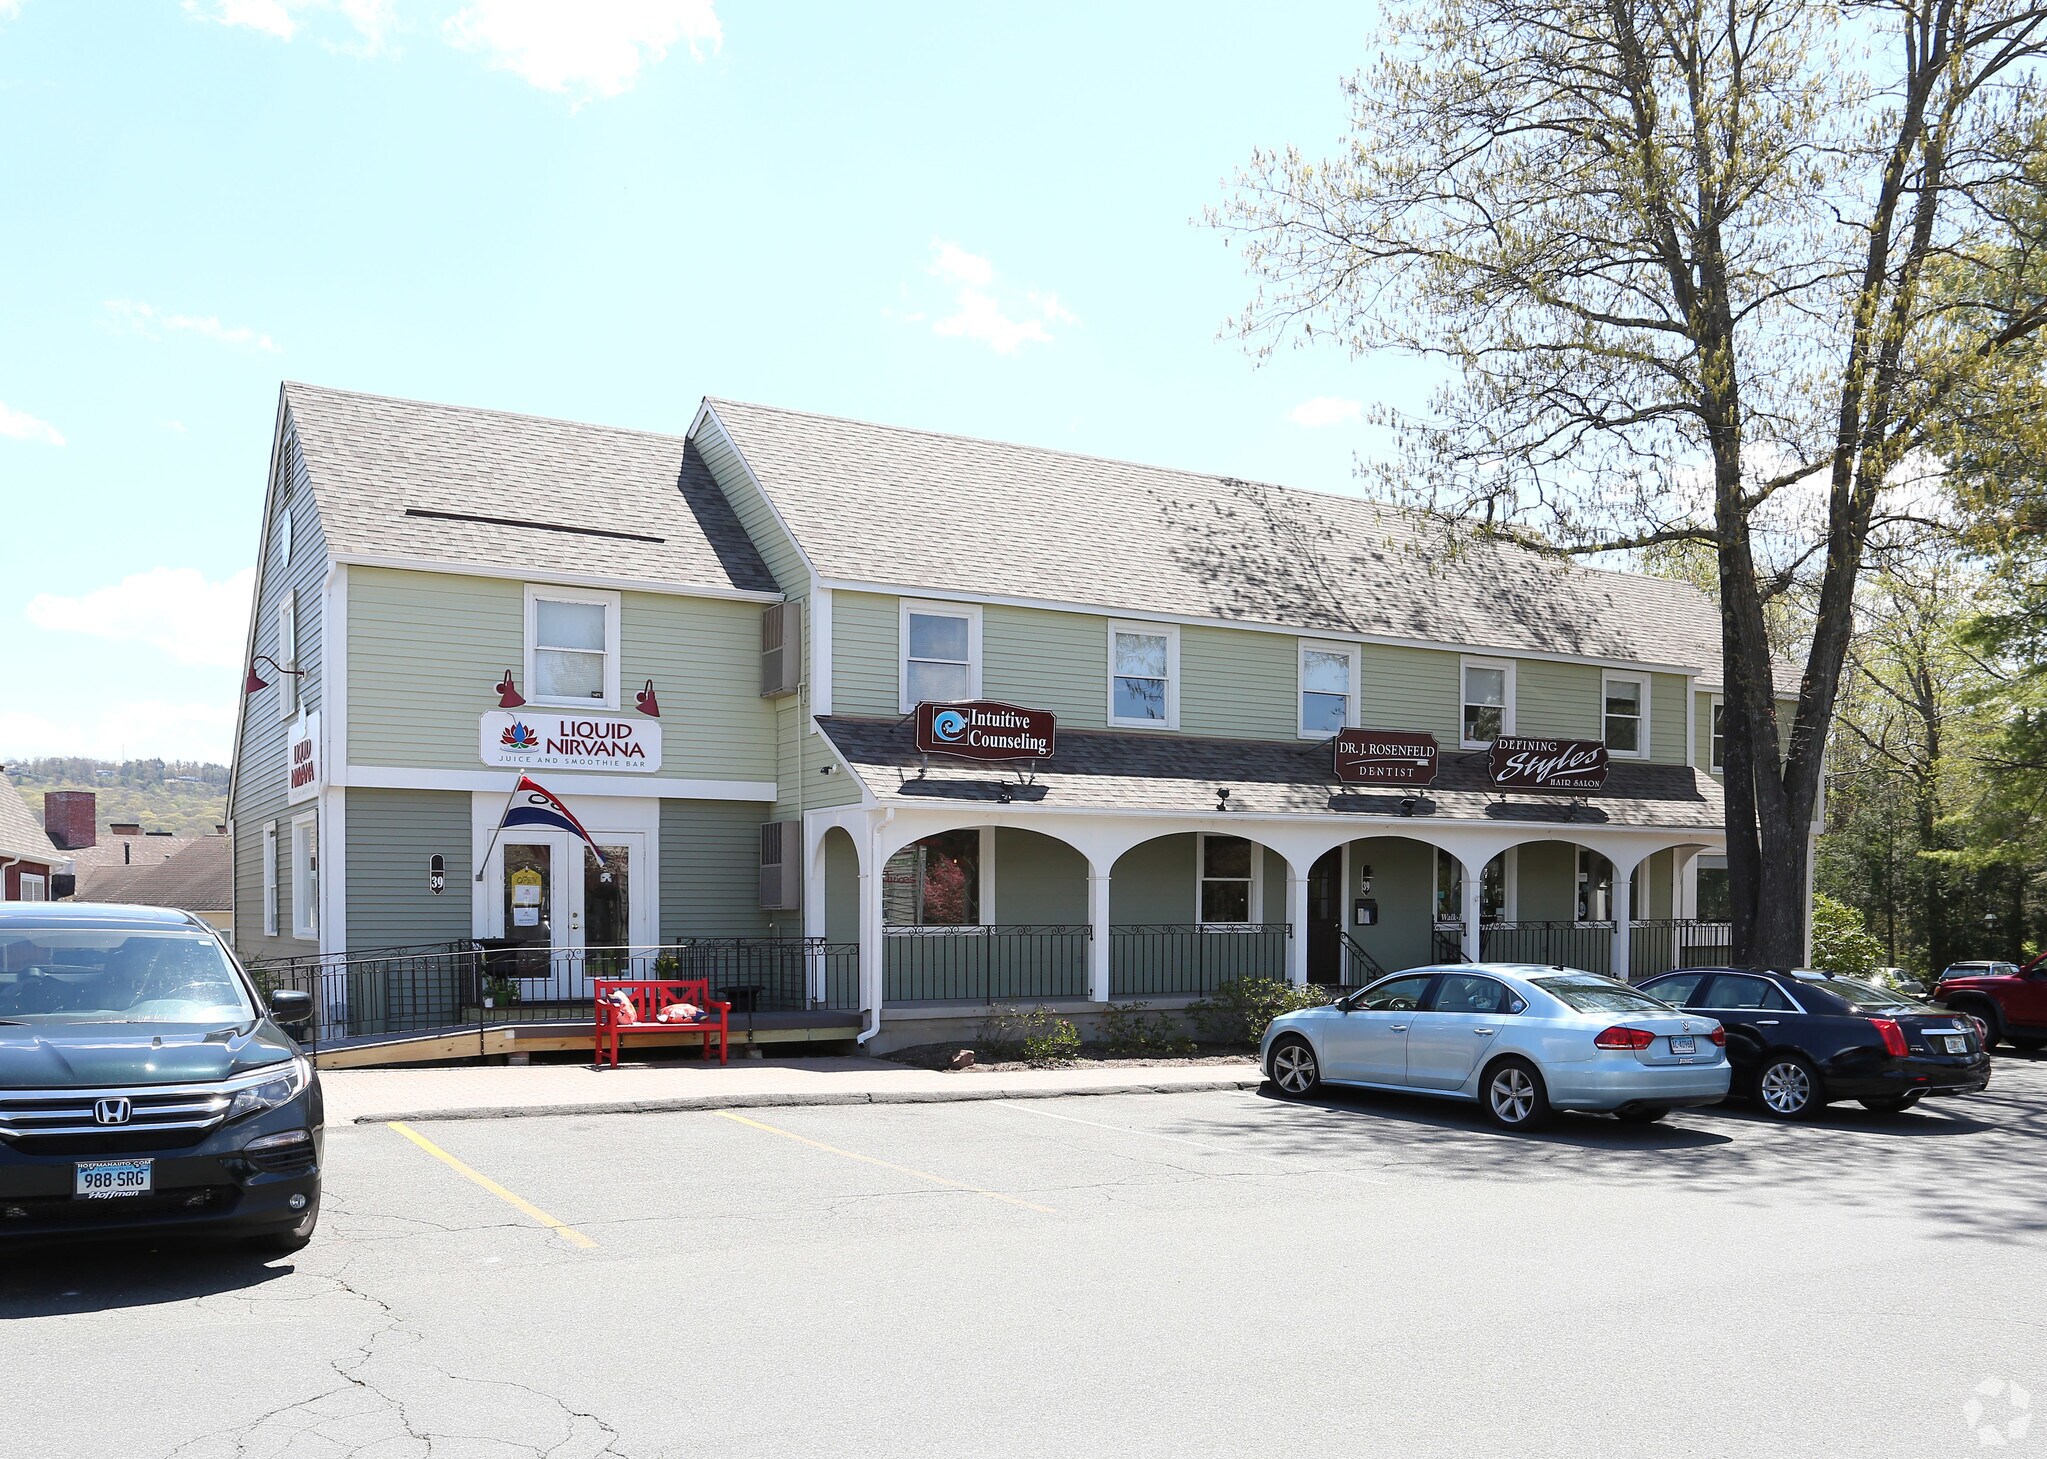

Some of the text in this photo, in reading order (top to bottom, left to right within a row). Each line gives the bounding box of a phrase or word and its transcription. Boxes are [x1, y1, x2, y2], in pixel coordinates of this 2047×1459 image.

[971, 709, 1030, 728] Intuitive
[560, 720, 632, 739] LIQUID
[546, 738, 646, 759] NIRVANA
[969, 730, 1047, 754] Counseling
[1498, 740, 1557, 752] DEFINING
[1339, 742, 1435, 757] DR. J. ROSENFELD
[499, 755, 531, 763] JUICE
[565, 758, 619, 767] SMOOTHIE
[626, 760, 645, 768] BAR
[1496, 743, 1602, 783] Styles
[1359, 766, 1414, 777] DENTIST
[1550, 778, 1600, 788] HAIR SALON
[431, 876, 444, 889] 39
[77, 1160, 151, 1169] HOFFMANAUTOCOM
[88, 1190, 139, 1199] Hoffman
